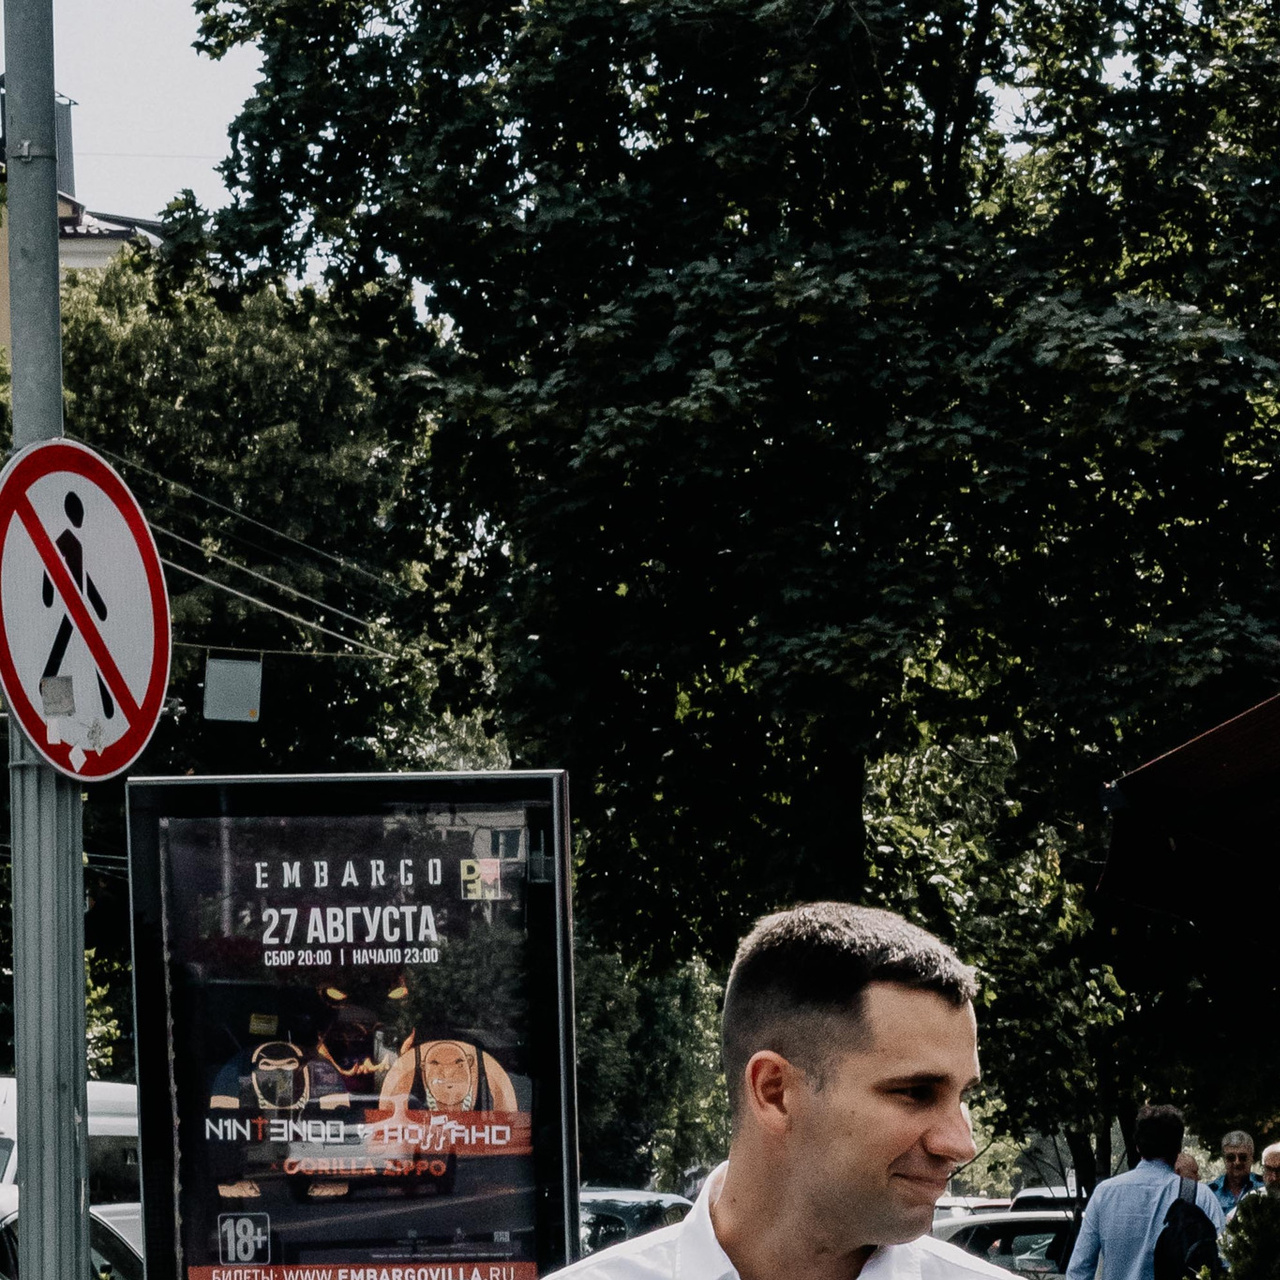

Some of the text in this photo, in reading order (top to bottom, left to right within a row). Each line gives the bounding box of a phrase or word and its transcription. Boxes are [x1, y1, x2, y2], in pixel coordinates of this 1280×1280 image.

[254, 858, 442, 888] EMBARGO
[262, 905, 438, 945] 27 АВГУСТА
[264, 948, 439, 966] СБОР 20:00 НАЧАЛО 23:00
[282, 1157, 377, 1176] GORILLA
[219, 1217, 267, 1262] 18+
